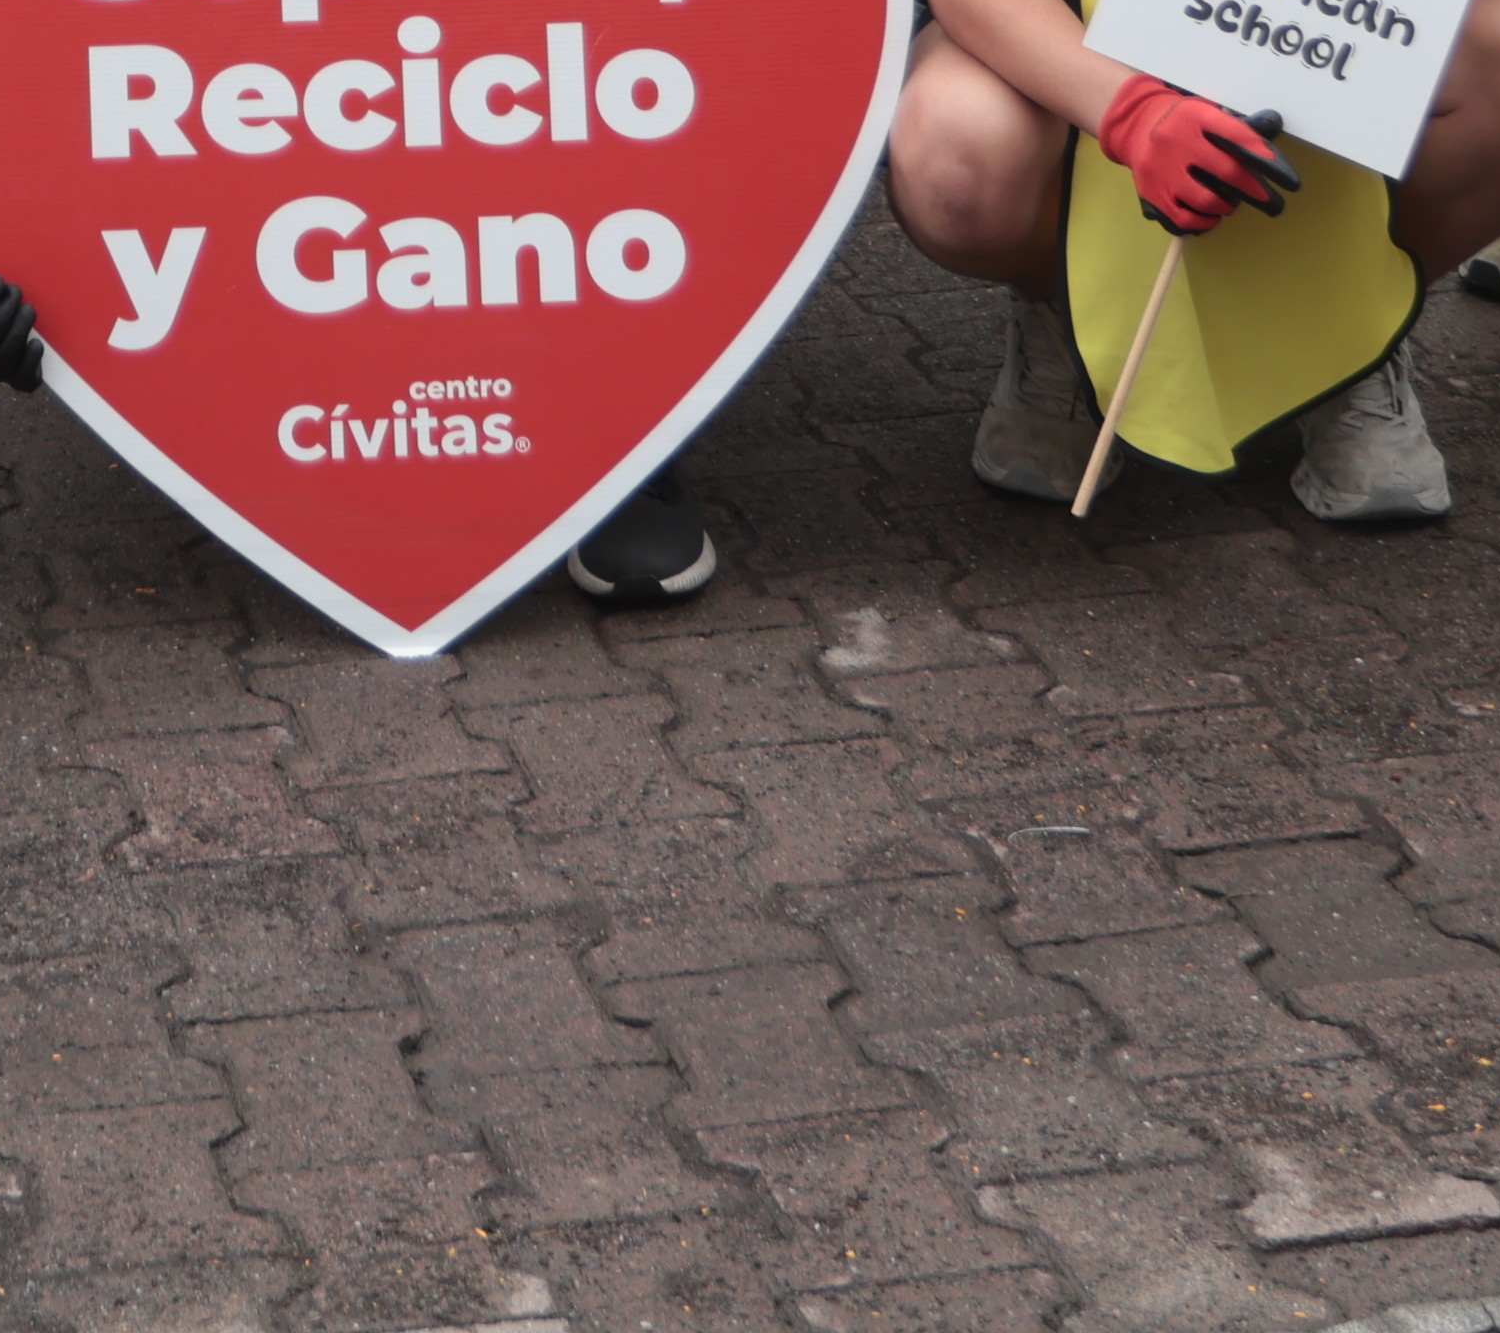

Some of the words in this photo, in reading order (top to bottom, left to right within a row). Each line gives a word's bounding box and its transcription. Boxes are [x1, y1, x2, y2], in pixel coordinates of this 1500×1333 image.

[87, 14, 697, 161] Reciclo
[101, 225, 207, 352] y
[255, 195, 687, 316] Gano
[408, 375, 513, 402] centro
